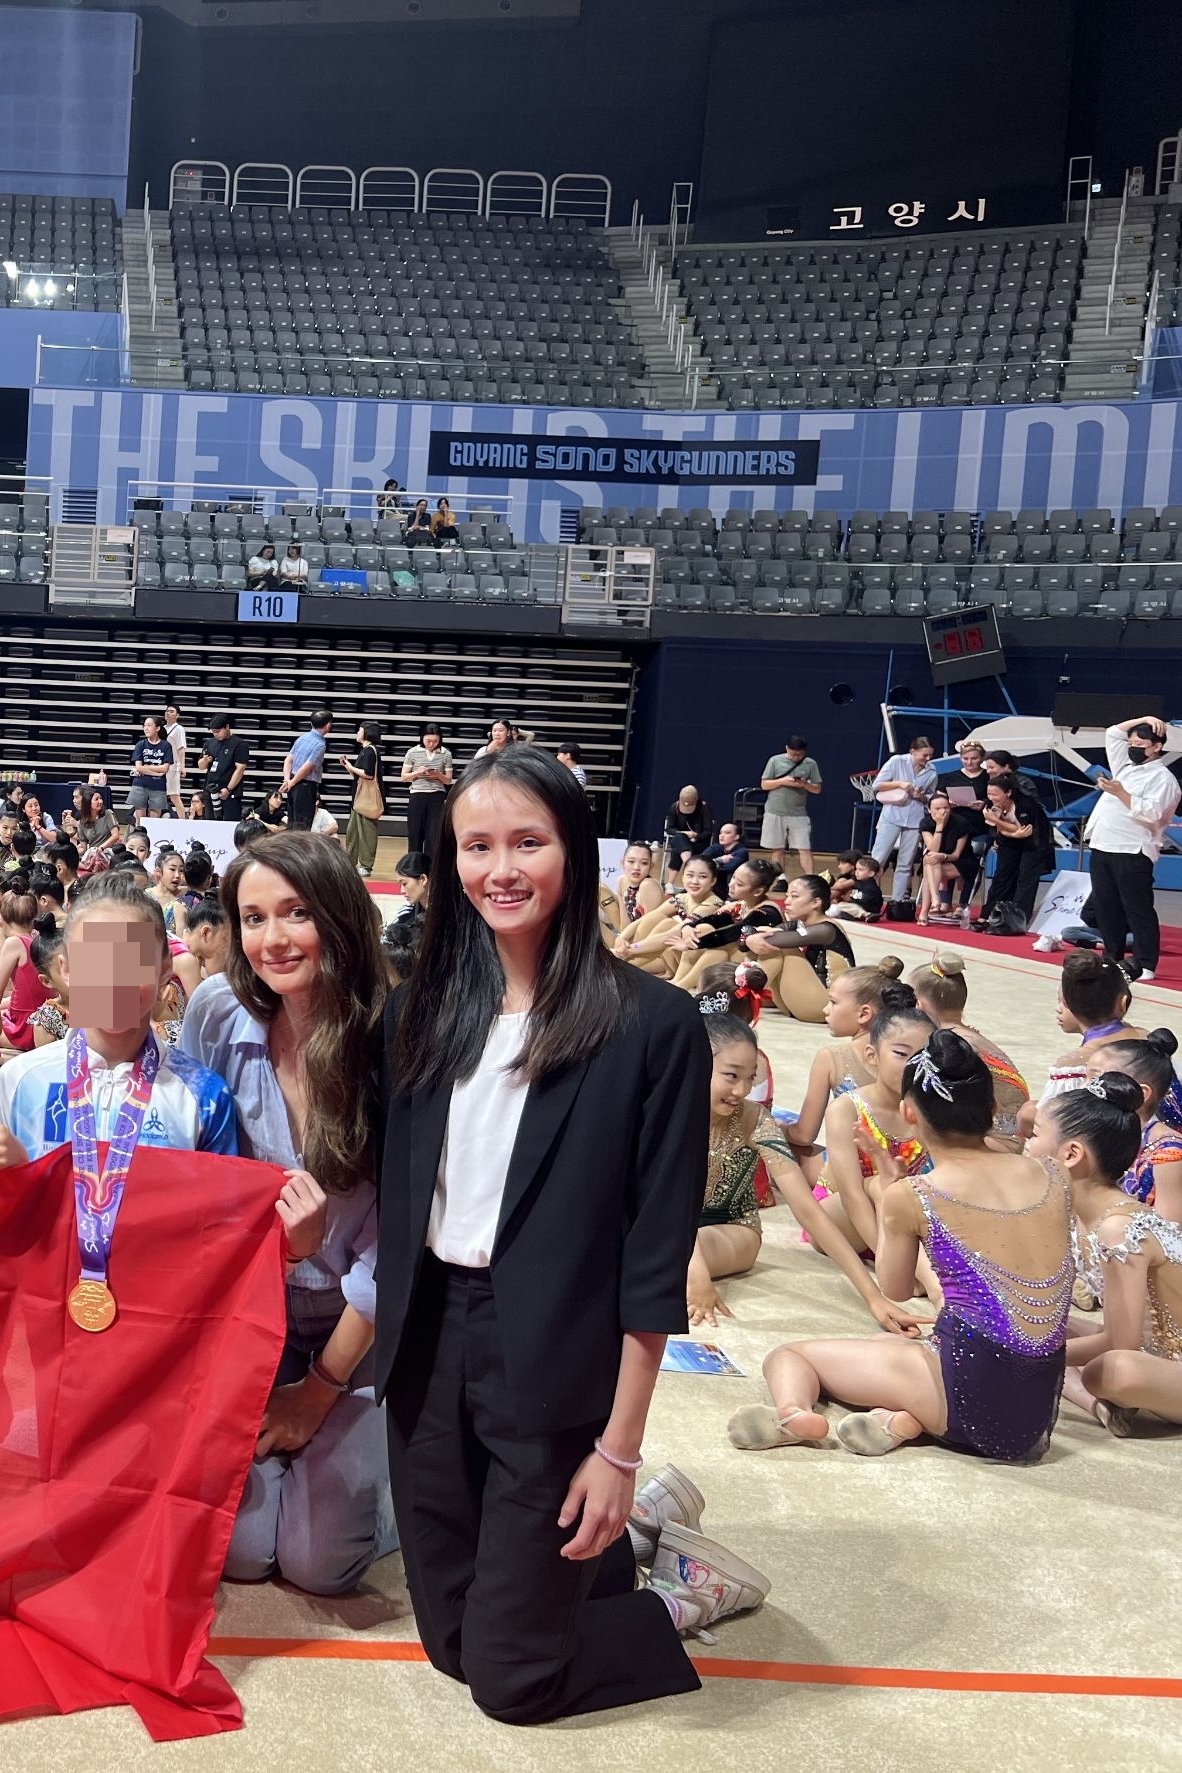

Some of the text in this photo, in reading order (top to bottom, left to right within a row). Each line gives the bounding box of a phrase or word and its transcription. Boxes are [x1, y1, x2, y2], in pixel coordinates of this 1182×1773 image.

[830, 198, 986, 230] 고양시
[32, 389, 228, 525] THE
[449, 441, 796, 476] GOYANG SONO SKYGUNNERS
[252, 596, 284, 619] R10
